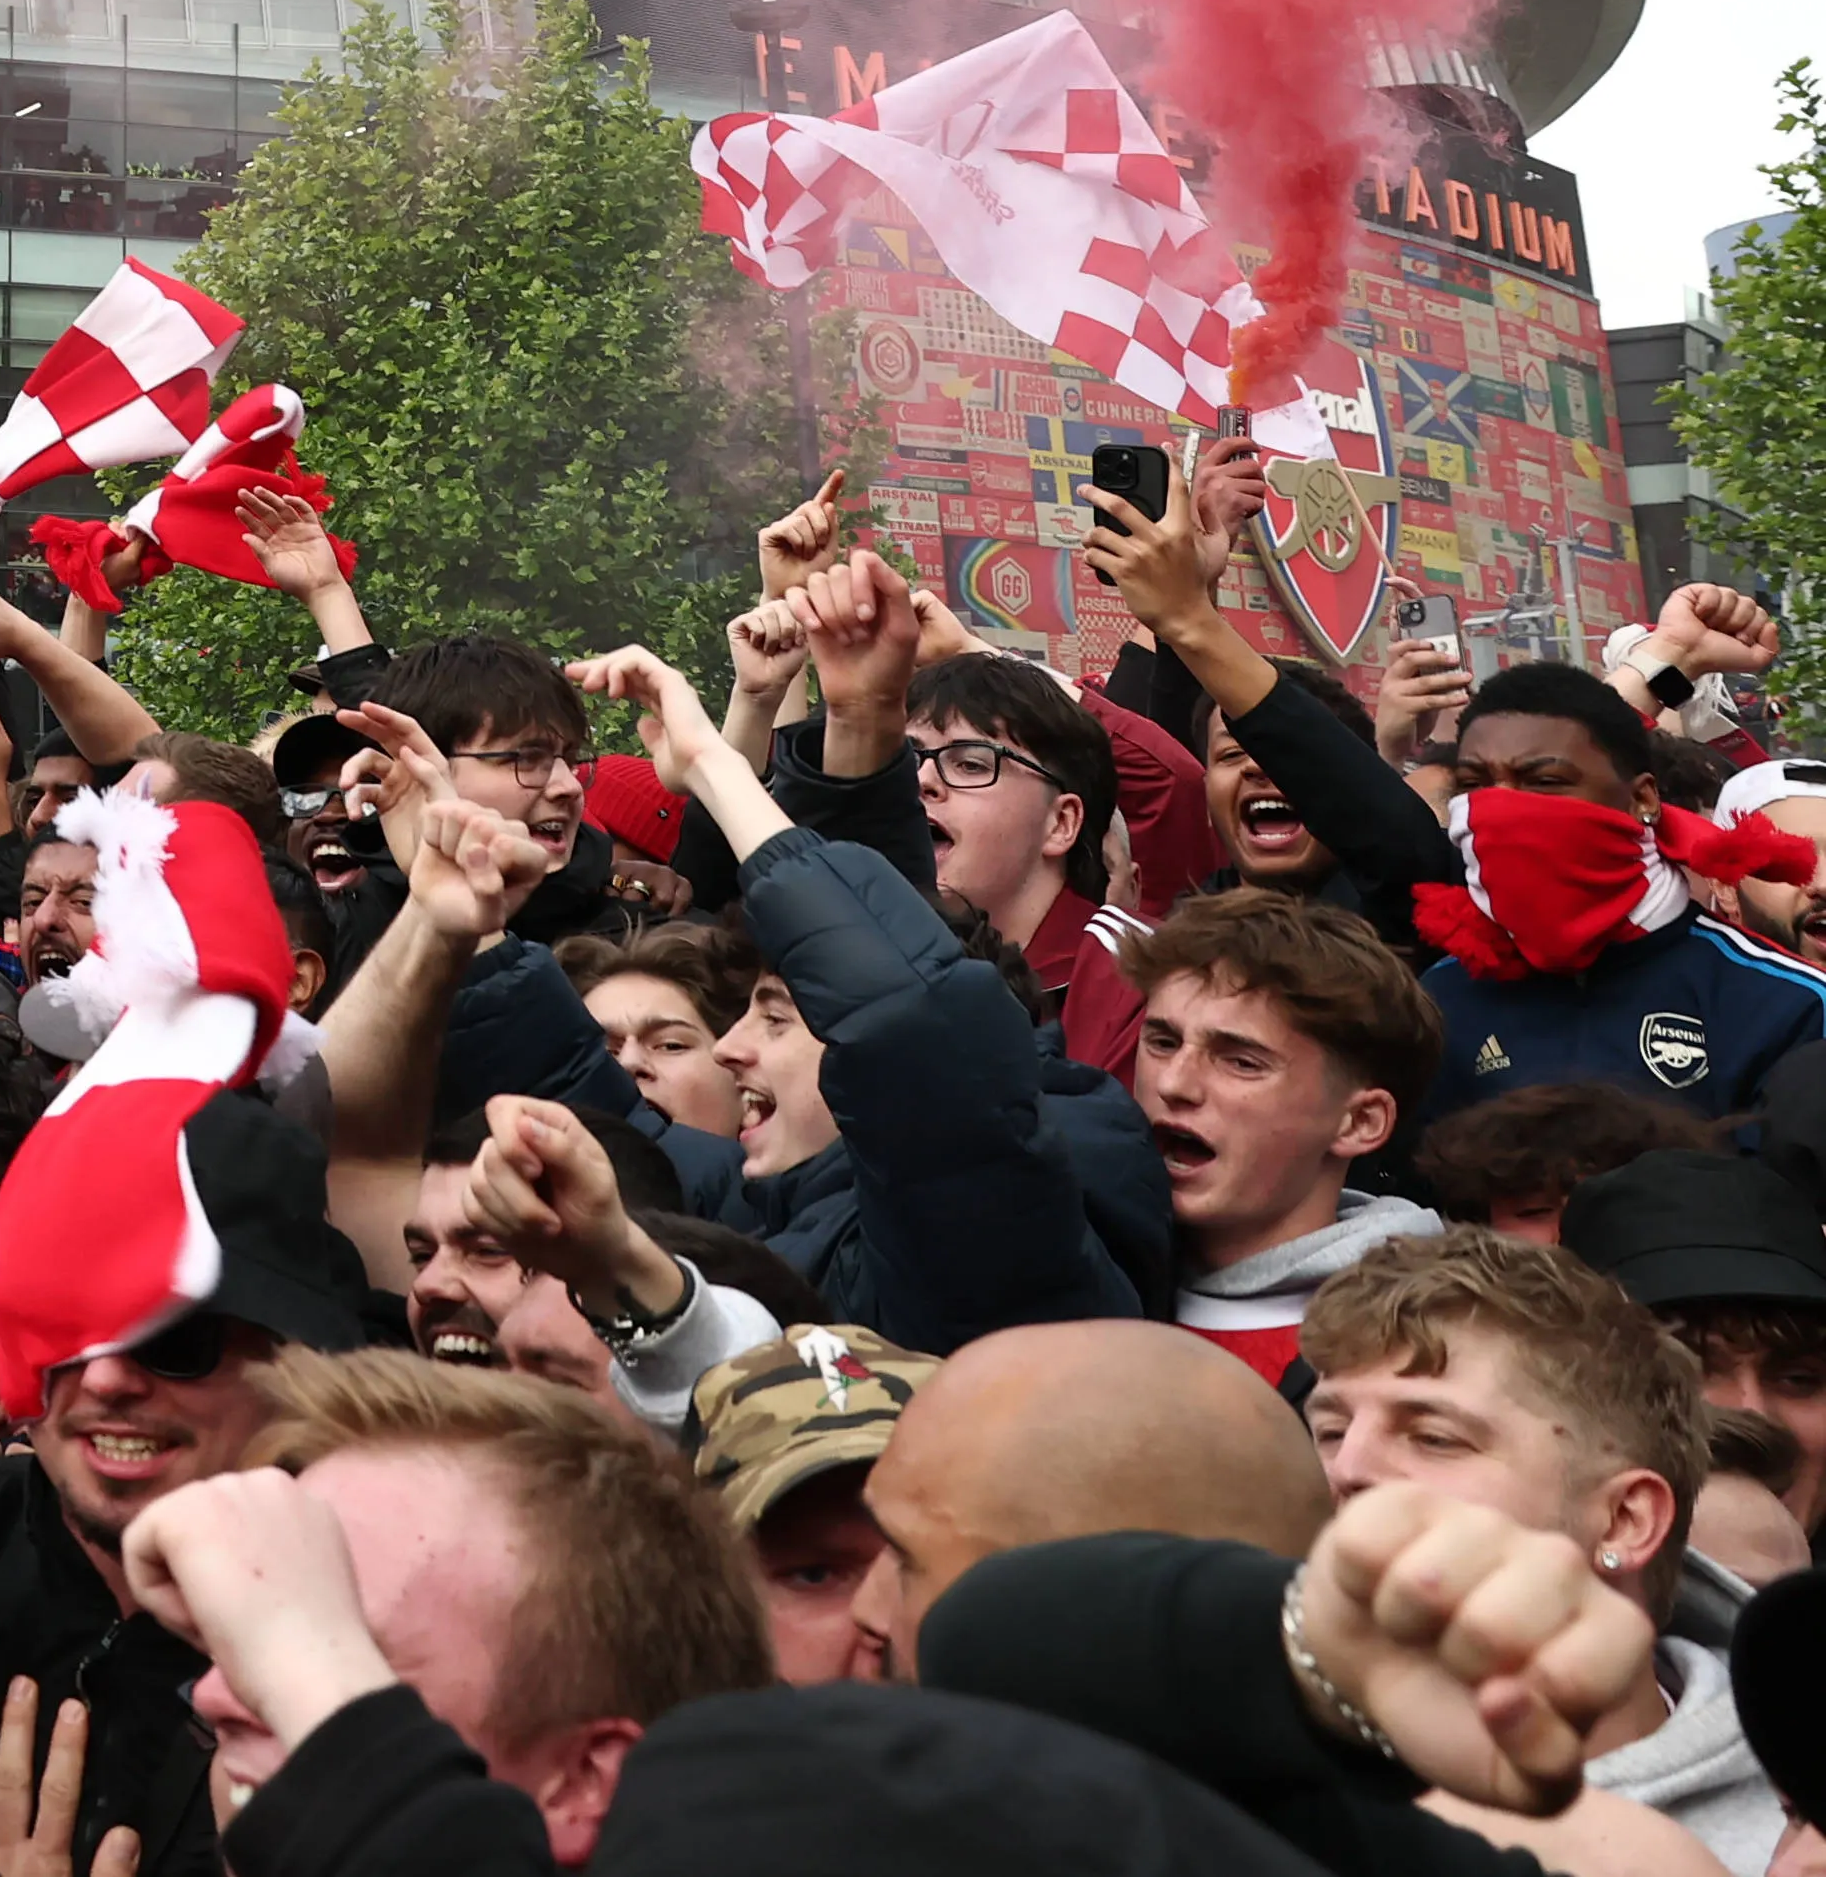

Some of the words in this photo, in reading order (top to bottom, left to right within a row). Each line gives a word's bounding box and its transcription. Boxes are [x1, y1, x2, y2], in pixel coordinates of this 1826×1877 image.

[1368, 155, 1577, 277] TADIUM
[1085, 400, 1166, 425] GUNNERS
[1305, 388, 1378, 435] enal
[1033, 453, 1092, 472] ARSENAL
[871, 488, 936, 504] ARSENAL
[1400, 476, 1446, 501] SENAL
[888, 521, 940, 534] ETNAM
[1402, 529, 1452, 551] RMANY
[1001, 576, 1023, 598] GG
[1077, 597, 1133, 614] ARSENAL
[1651, 1023, 1706, 1044] Arsenal
